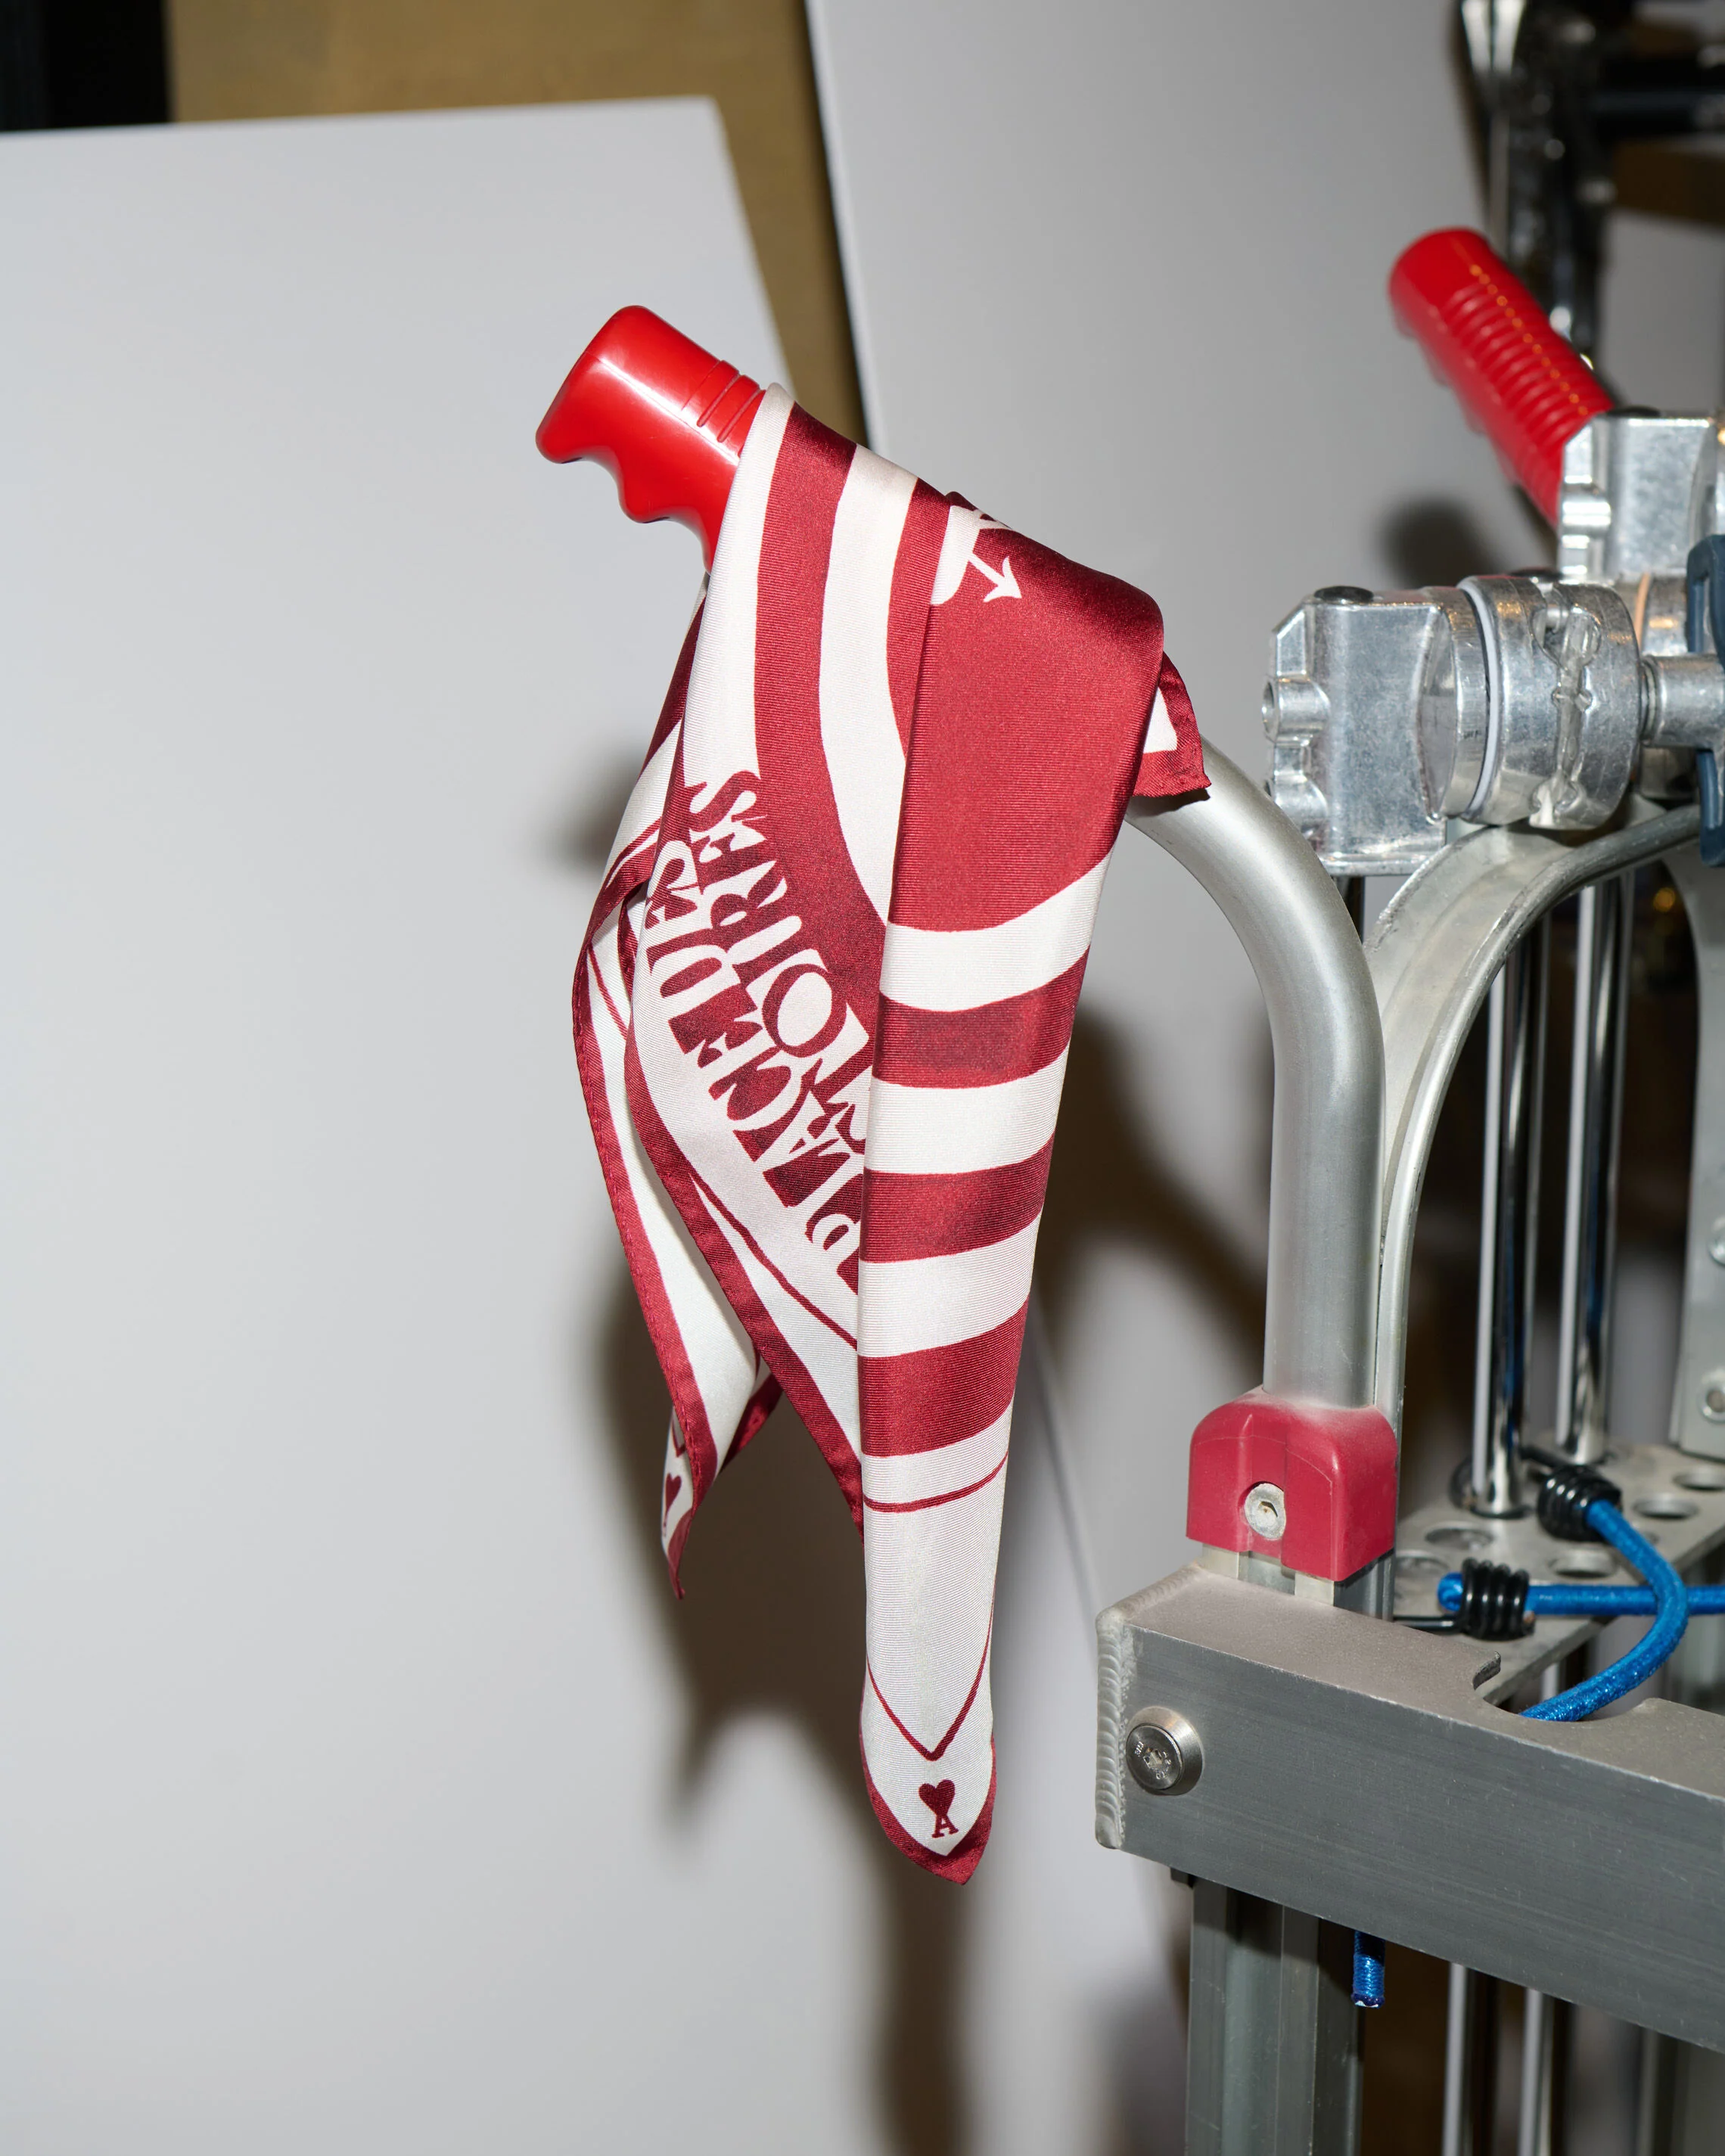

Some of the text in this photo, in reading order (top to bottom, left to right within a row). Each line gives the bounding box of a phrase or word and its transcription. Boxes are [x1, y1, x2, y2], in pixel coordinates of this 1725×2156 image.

[647, 840, 860, 1274] PLACE DES
[931, 1815, 959, 1838] A
